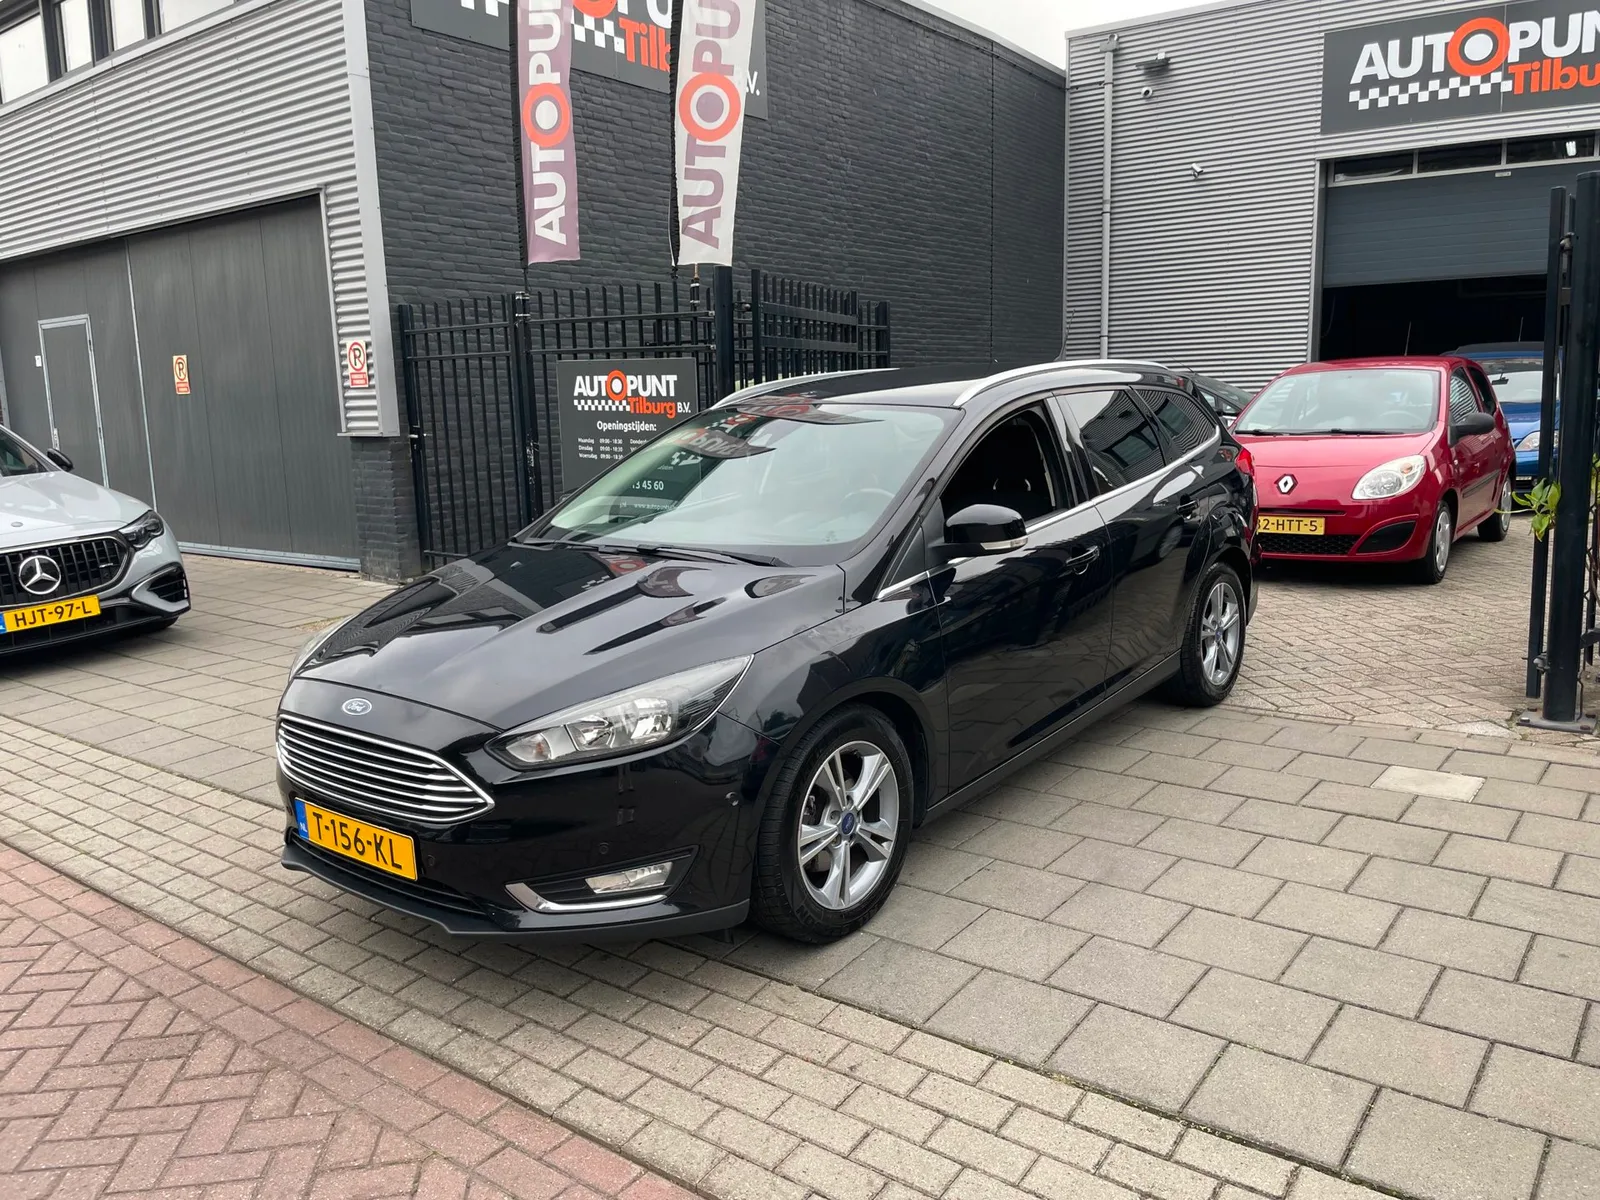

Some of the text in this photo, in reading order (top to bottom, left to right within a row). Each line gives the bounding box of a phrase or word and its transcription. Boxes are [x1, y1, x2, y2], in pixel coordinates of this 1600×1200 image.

[522, 0, 570, 245] AUTOPU
[573, 370, 678, 401] AUTOPUNT
[627, 397, 692, 419] Tilburg B.V.
[596, 420, 657, 432] Openingstijden:
[641, 481, 652, 490] 45
[653, 481, 665, 491] 60
[14, 600, 92, 628] HJT-97-L
[312, 811, 403, 871] T-156-KL
